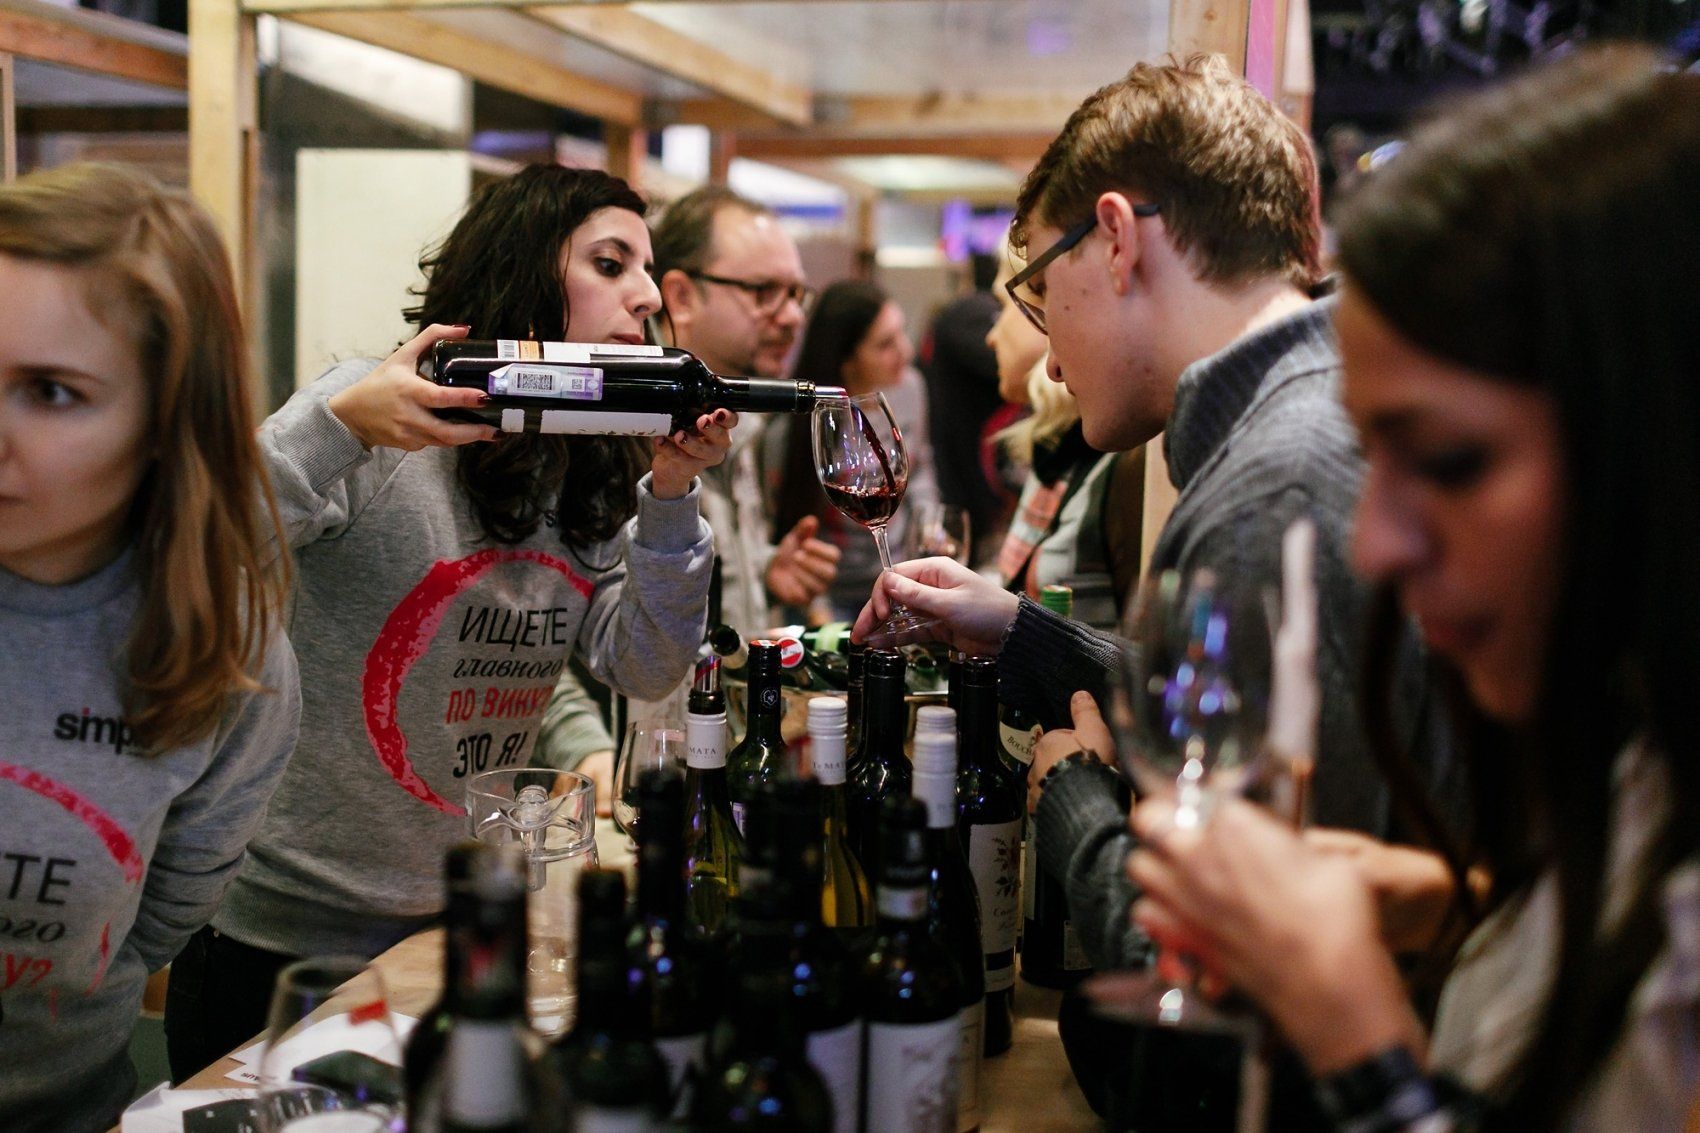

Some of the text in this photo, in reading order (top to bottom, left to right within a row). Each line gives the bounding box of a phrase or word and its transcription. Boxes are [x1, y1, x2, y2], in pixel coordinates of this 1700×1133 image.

[458, 606, 568, 652] ИЩЕТЕ
[453, 658, 564, 679] главного
[445, 687, 476, 724] ПО
[54, 706, 134, 755] simp
[1007, 735, 1034, 756] BOUCH
[453, 731, 528, 779] ЭТО Я!
[0, 852, 77, 906] ТЕ
[0, 950, 53, 993] У?
